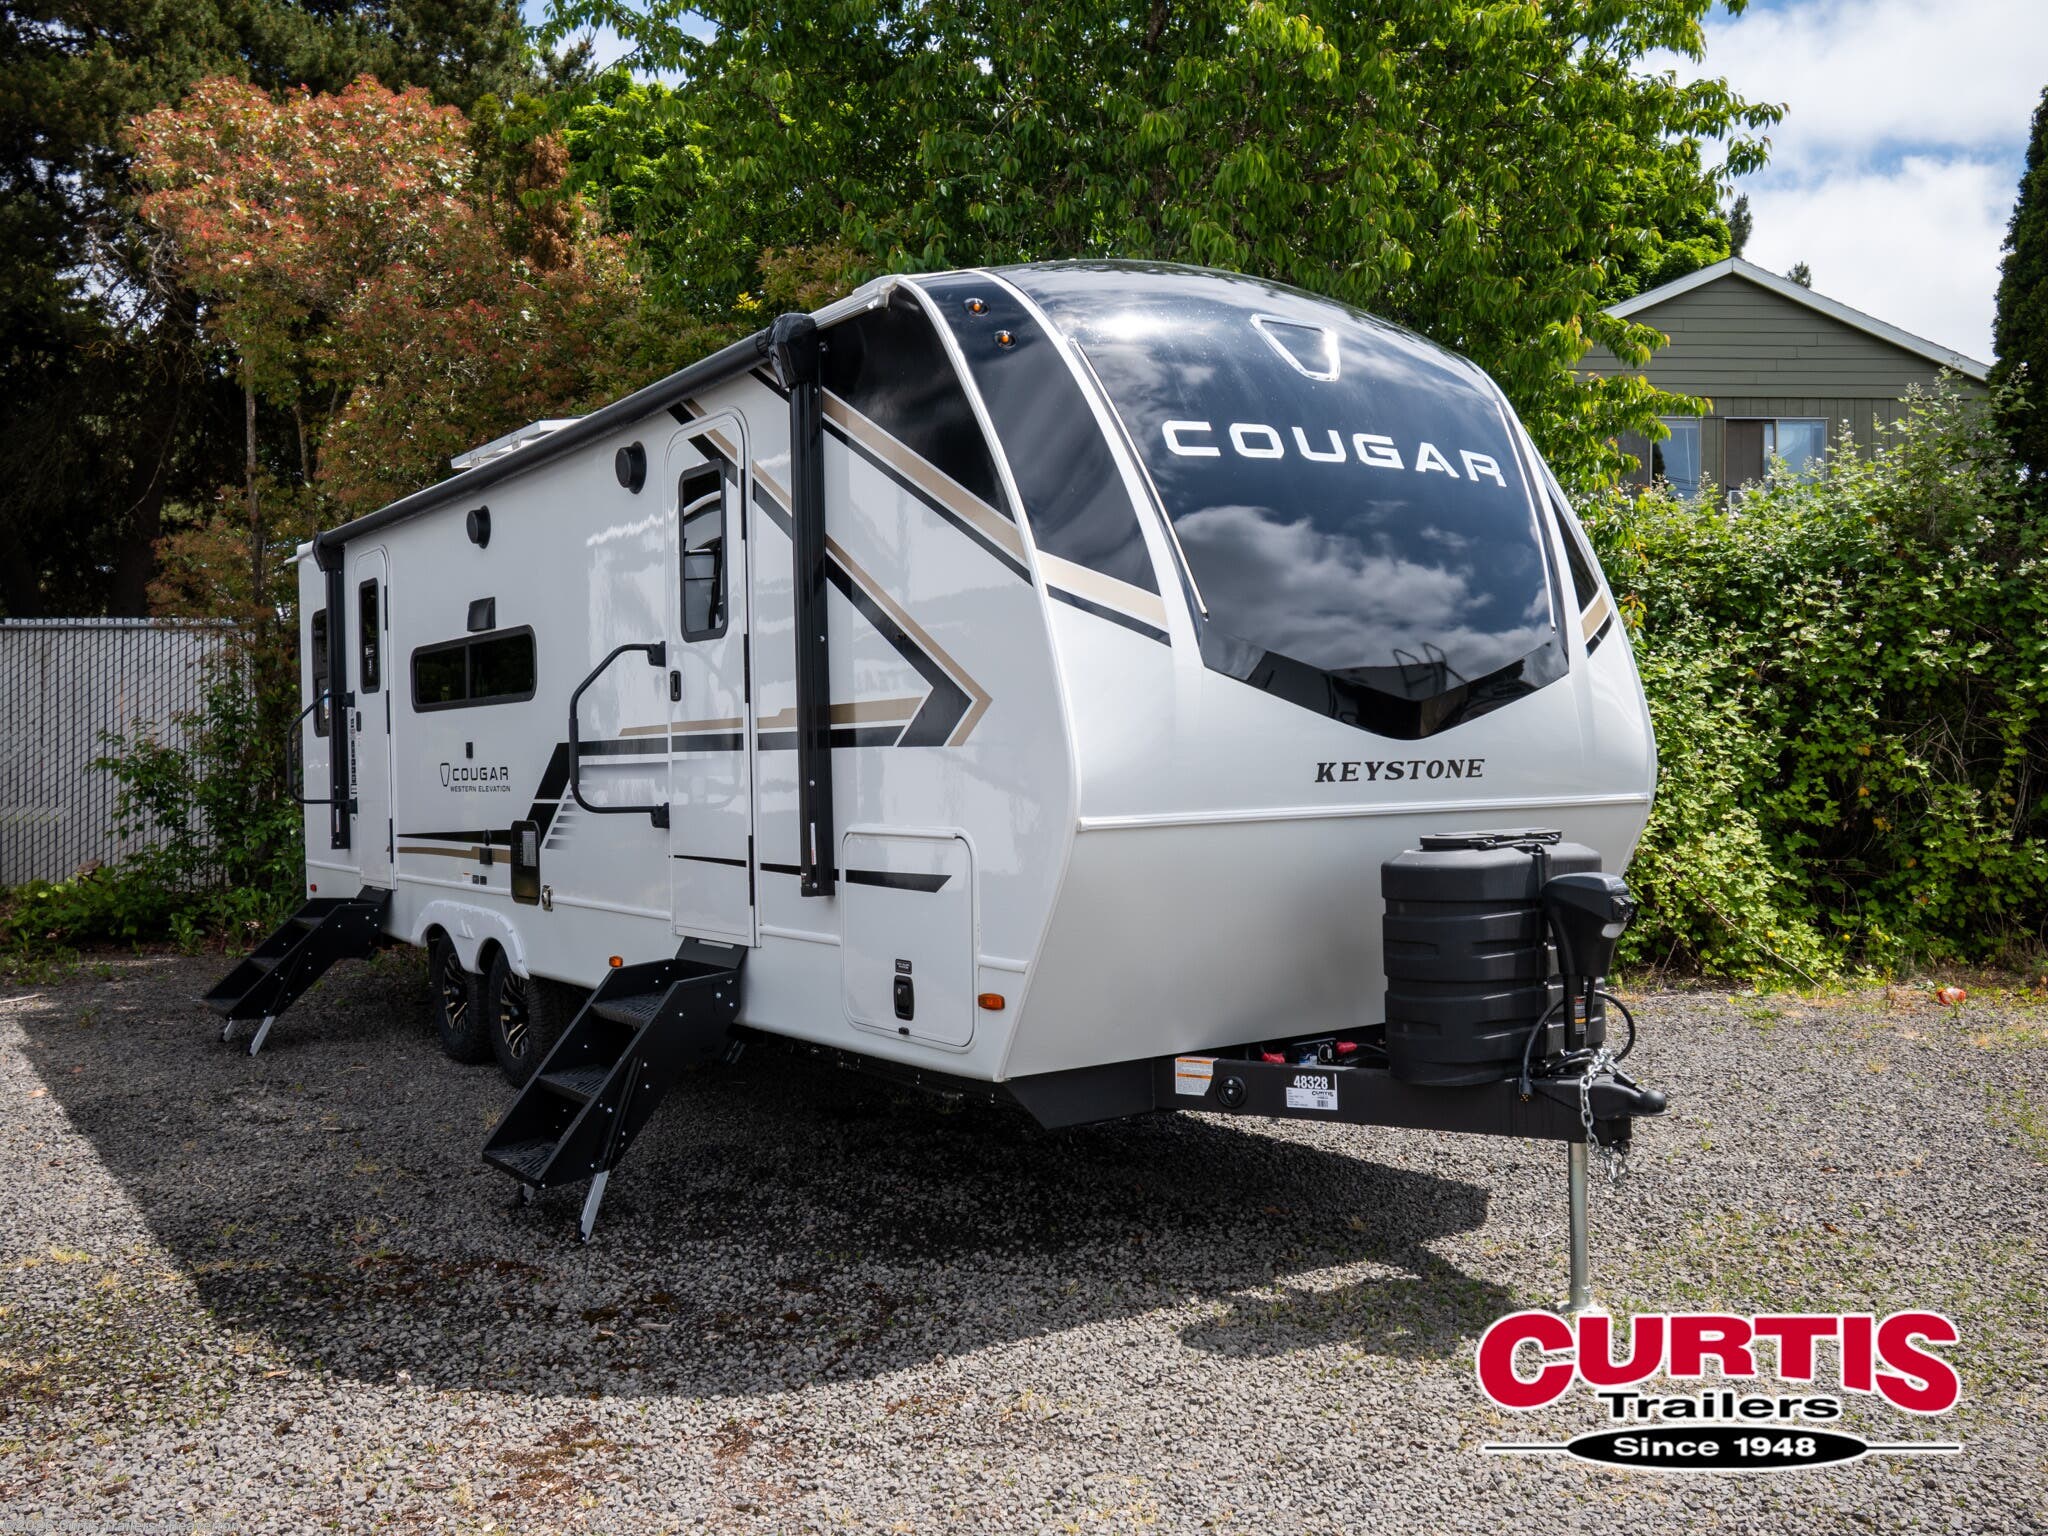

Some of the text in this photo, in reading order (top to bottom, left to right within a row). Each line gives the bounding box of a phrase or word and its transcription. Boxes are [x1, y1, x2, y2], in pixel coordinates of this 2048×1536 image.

[1161, 420, 1507, 487] COUGAR
[452, 766, 509, 782] COUGAR
[1314, 758, 1486, 783] KEYSTONE
[450, 785, 511, 793] WESTERN ELEVATION
[1293, 1074, 1328, 1090] 48328
